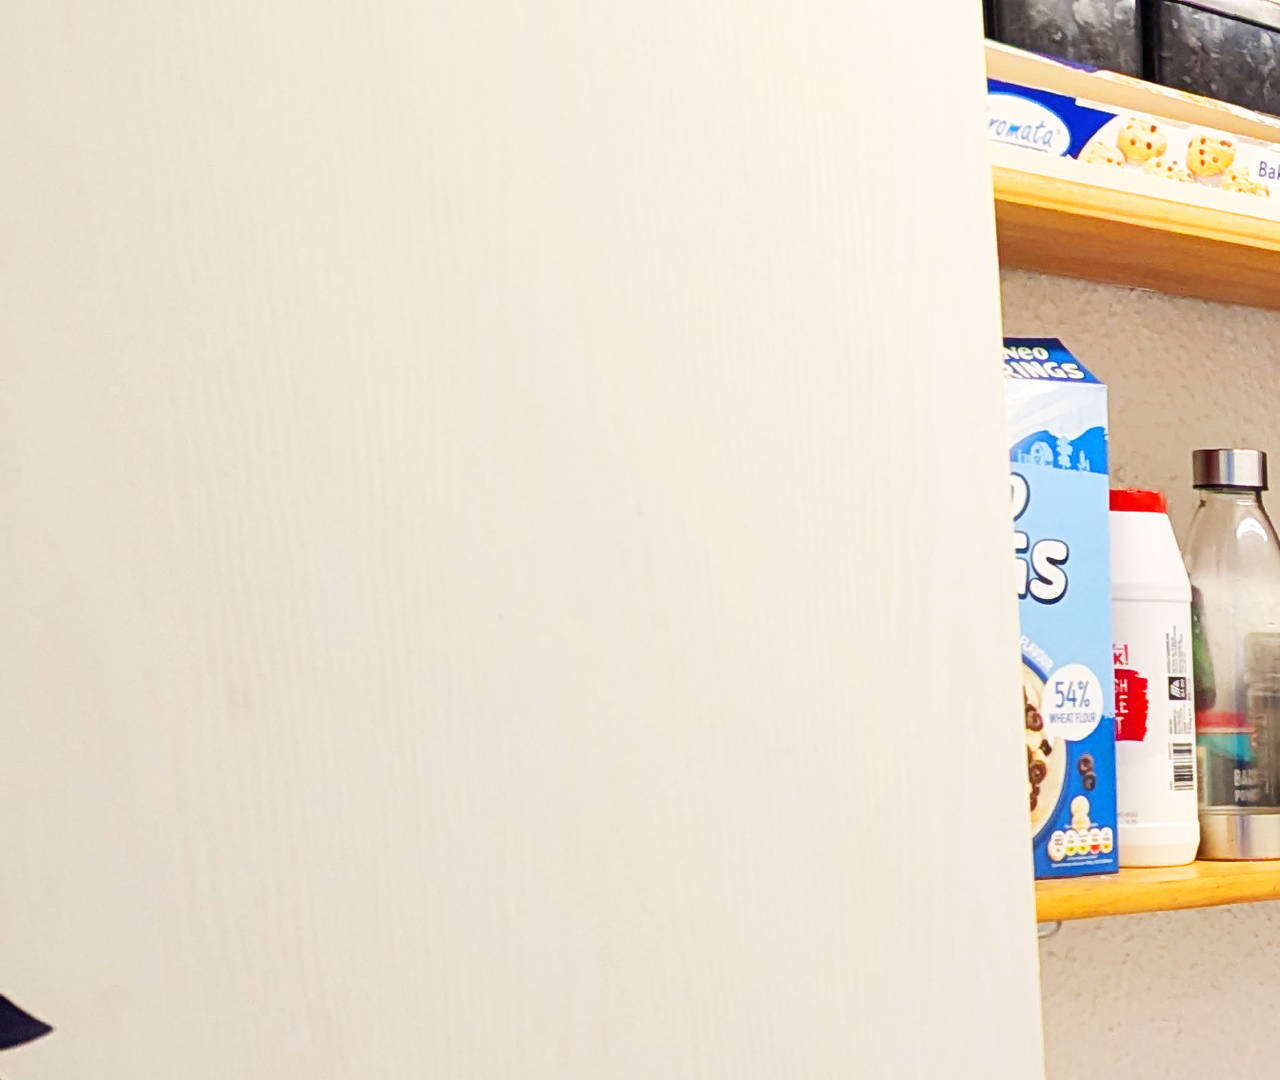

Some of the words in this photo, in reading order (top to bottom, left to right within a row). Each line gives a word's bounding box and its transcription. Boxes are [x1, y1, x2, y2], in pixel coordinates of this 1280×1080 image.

[1055, 681, 1091, 708] 54%
[1049, 712, 1073, 723] WHEAT
[1075, 711, 1097, 723] FLOUR
